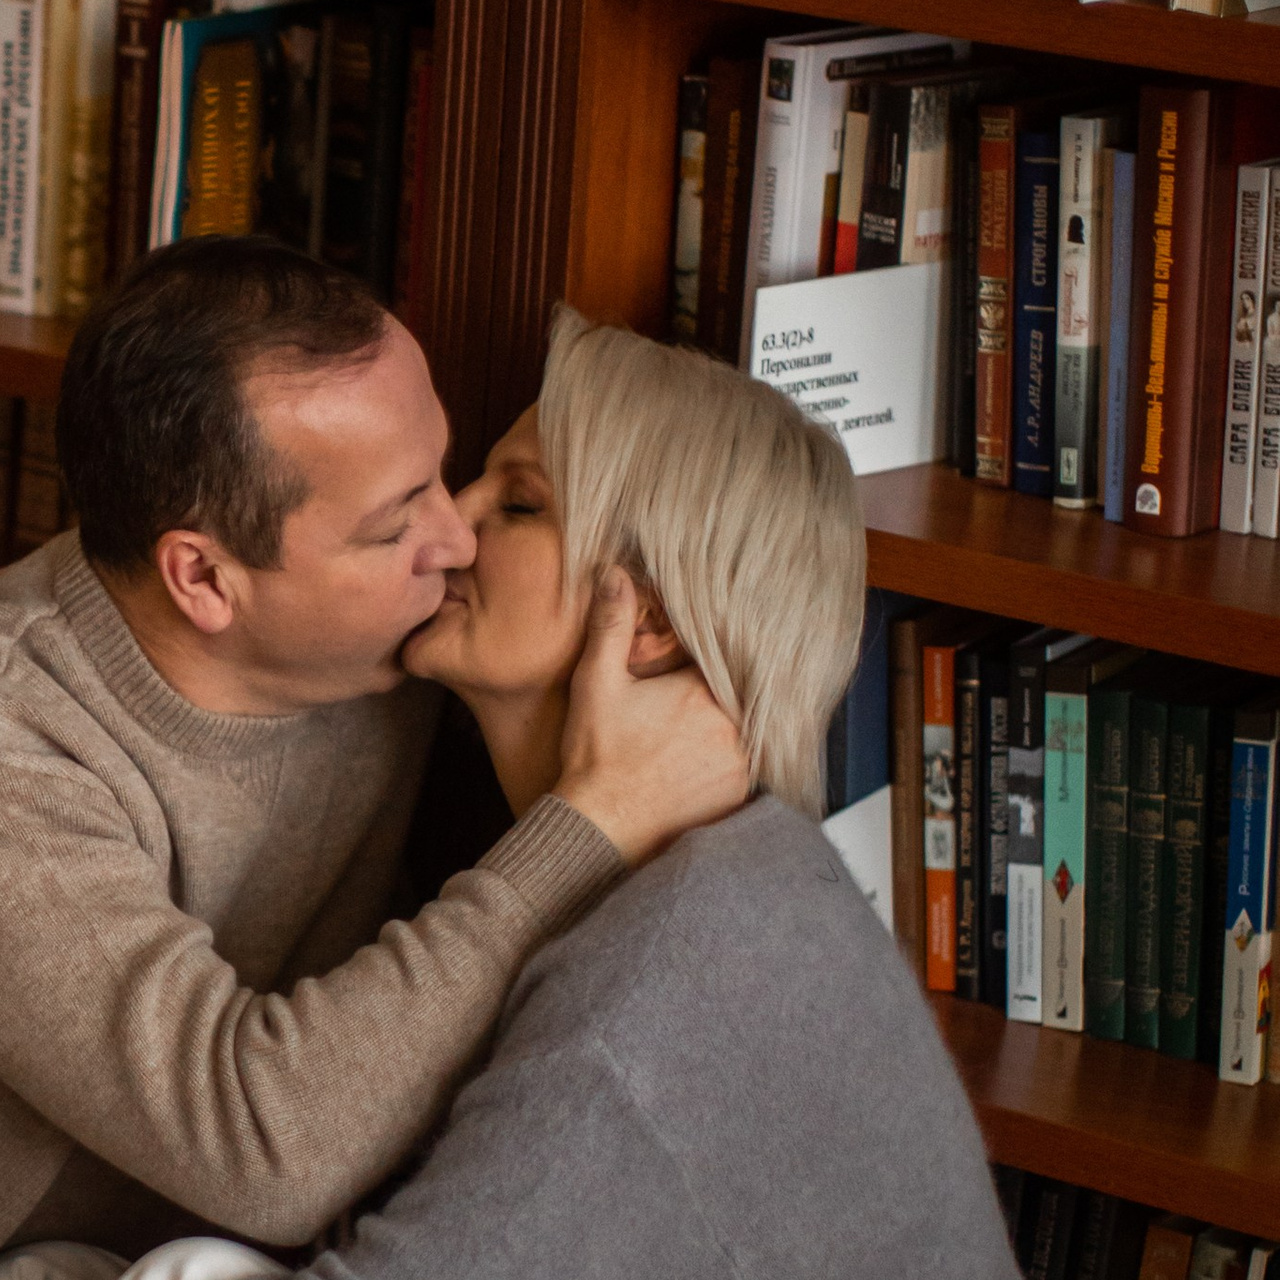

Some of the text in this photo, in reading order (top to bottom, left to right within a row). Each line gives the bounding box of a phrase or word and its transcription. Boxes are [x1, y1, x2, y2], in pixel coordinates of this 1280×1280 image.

[1158, 110, 1177, 160] России
[1156, 174, 1175, 226] Москве
[1032, 183, 1049, 287] СТРОГАНОВЫ
[1153, 228, 1171, 281] службе
[1239, 189, 1260, 280] ВОЛКОНСКИЕ
[761, 327, 814, 351] 63.3(2)-8
[761, 352, 832, 377] Персоналии
[1230, 423, 1247, 467] САРА
[1262, 424, 1279, 469] САРА
